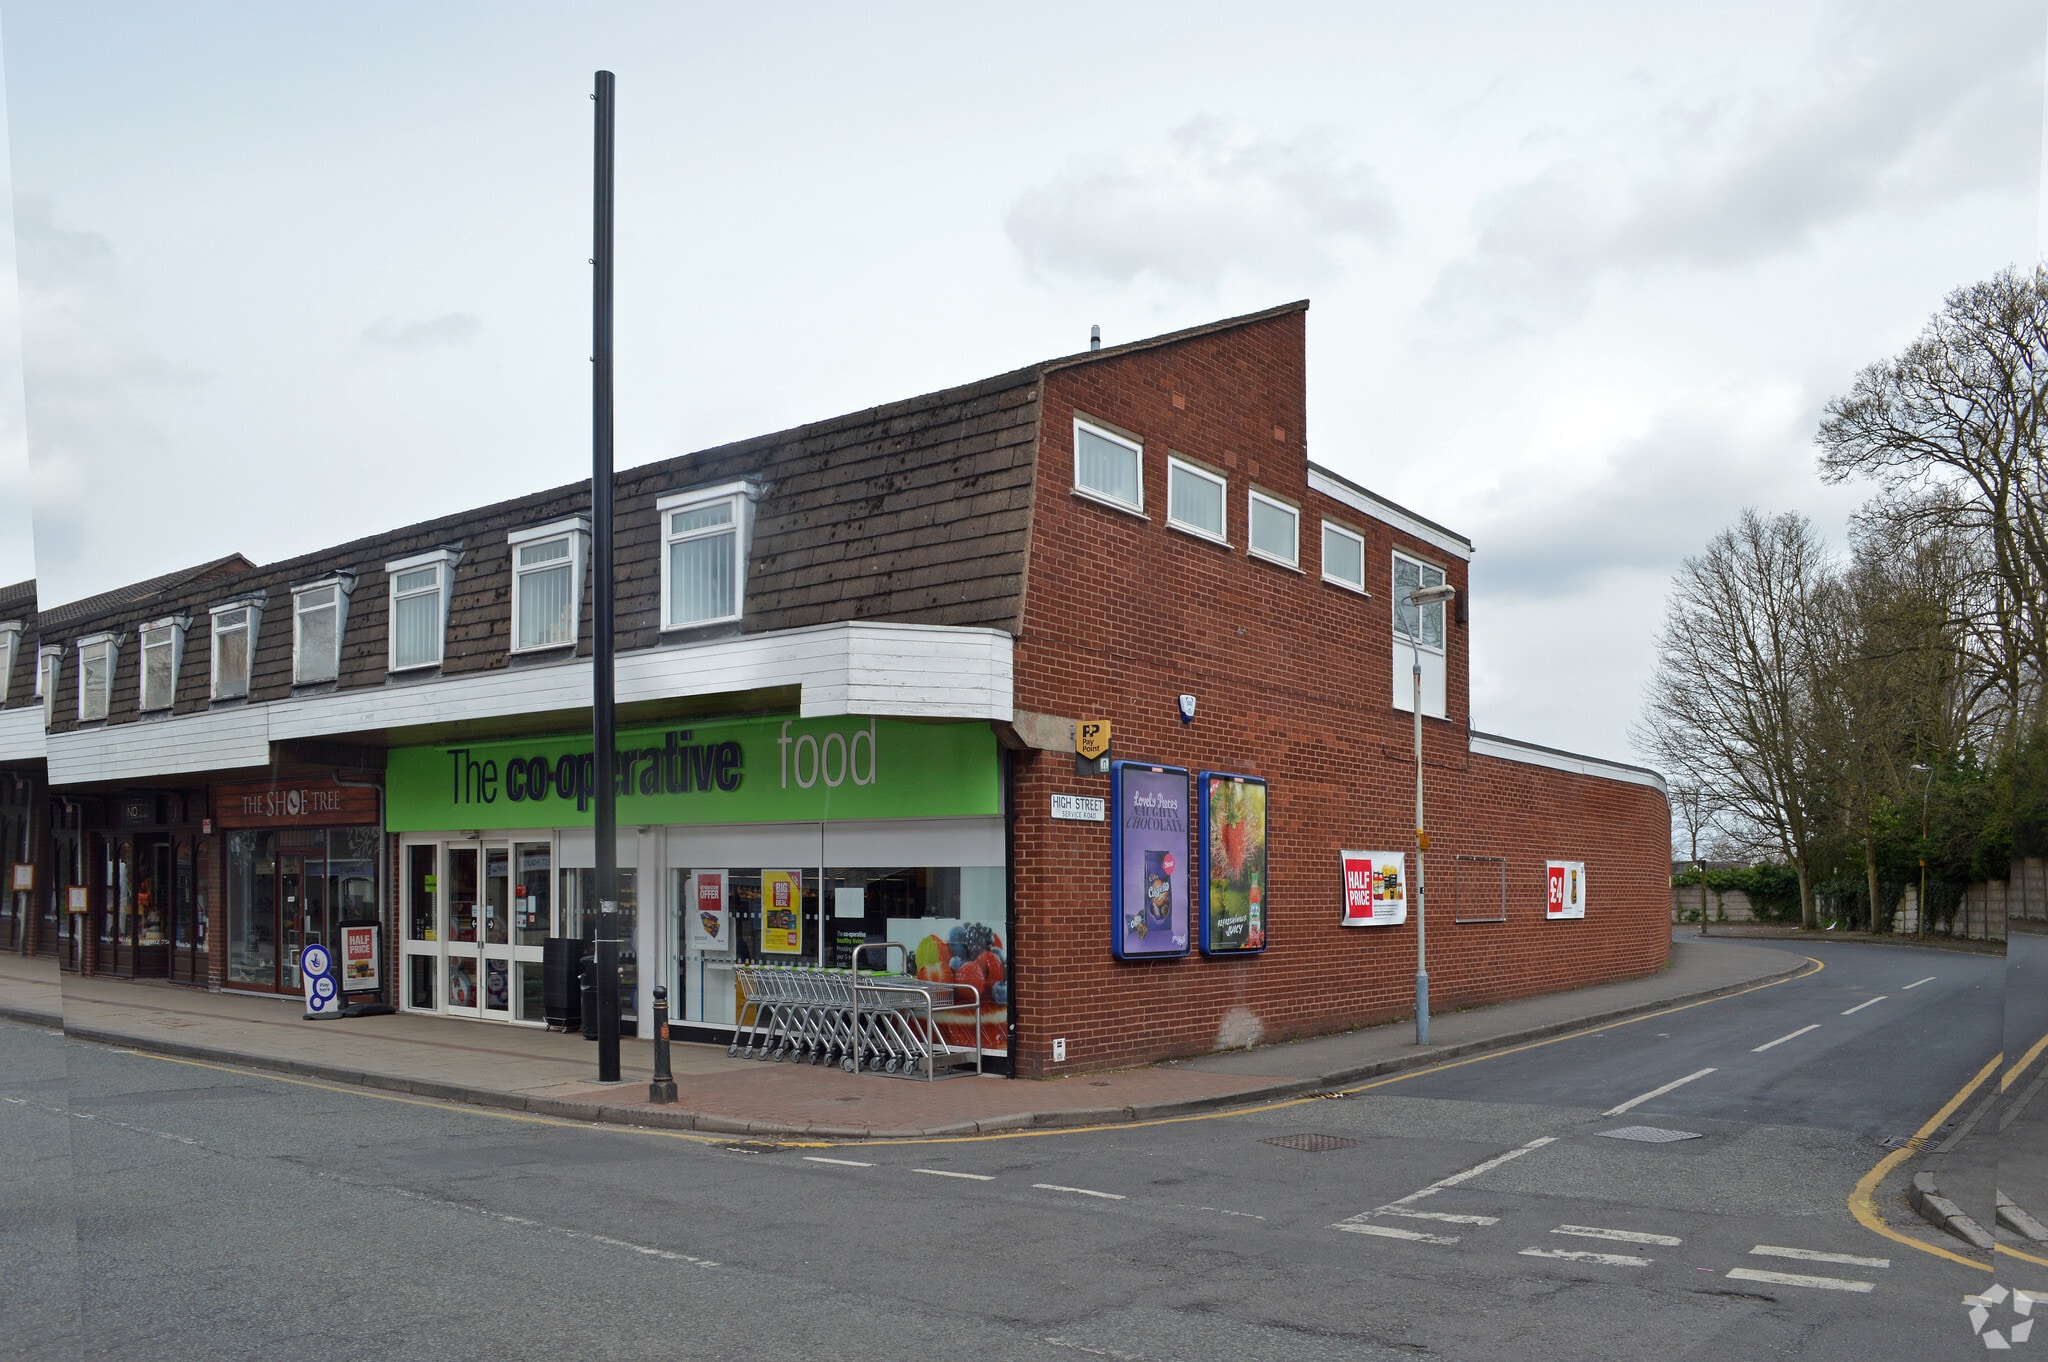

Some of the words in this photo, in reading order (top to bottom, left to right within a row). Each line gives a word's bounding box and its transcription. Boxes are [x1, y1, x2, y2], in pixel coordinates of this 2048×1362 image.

[1082, 739, 1095, 747] Pay
[1082, 745, 1100, 753] Point
[446, 748, 498, 805] The
[777, 717, 876, 789] food
[242, 796, 263, 814] THE
[266, 790, 309, 817] SHOE
[312, 791, 341, 811] TREE
[1052, 795, 1072, 809] HIGH
[1075, 797, 1103, 812] STREET
[1133, 790, 1156, 808] Lovely
[1062, 810, 1082, 818] SERVICE
[1083, 811, 1097, 820] ROAD
[1126, 815, 1185, 832] CHOCOLATE
[1347, 871, 1370, 889] HALF
[700, 889, 719, 900] OFFER
[775, 882, 788, 893] BIG
[1550, 876, 1563, 904] £4
[775, 899, 788, 907] DEAL
[1349, 890, 1370, 906] PRICE
[1225, 923, 1244, 937] JUICY
[349, 934, 370, 945] HALF
[350, 944, 371, 954] PRICE
